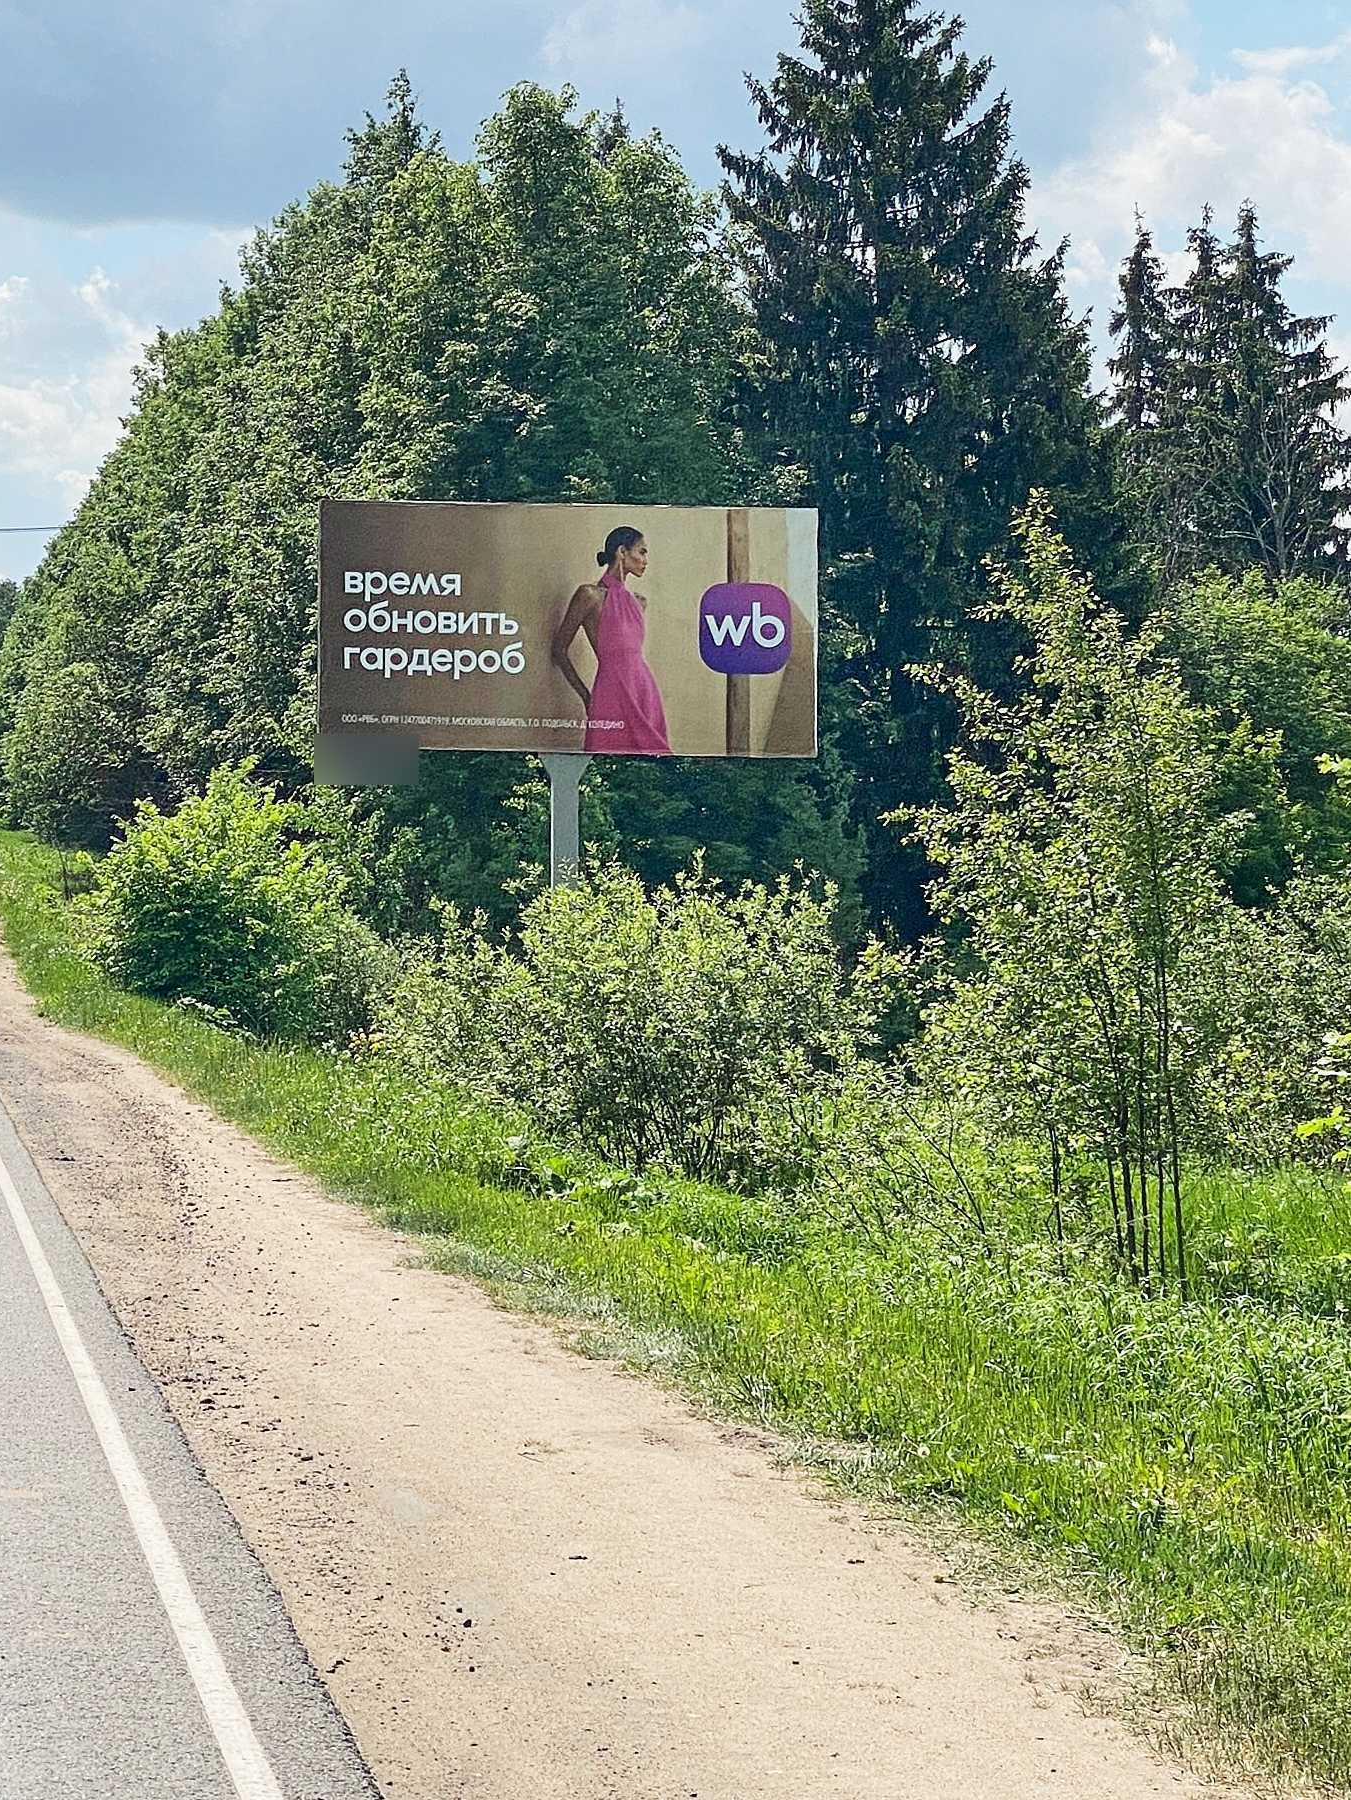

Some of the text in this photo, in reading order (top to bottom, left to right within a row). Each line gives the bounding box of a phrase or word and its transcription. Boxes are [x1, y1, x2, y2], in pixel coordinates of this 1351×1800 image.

[344, 571, 462, 602] время
[343, 600, 519, 635] обновить
[705, 602, 785, 648] wb
[343, 641, 525, 680] гардероб
